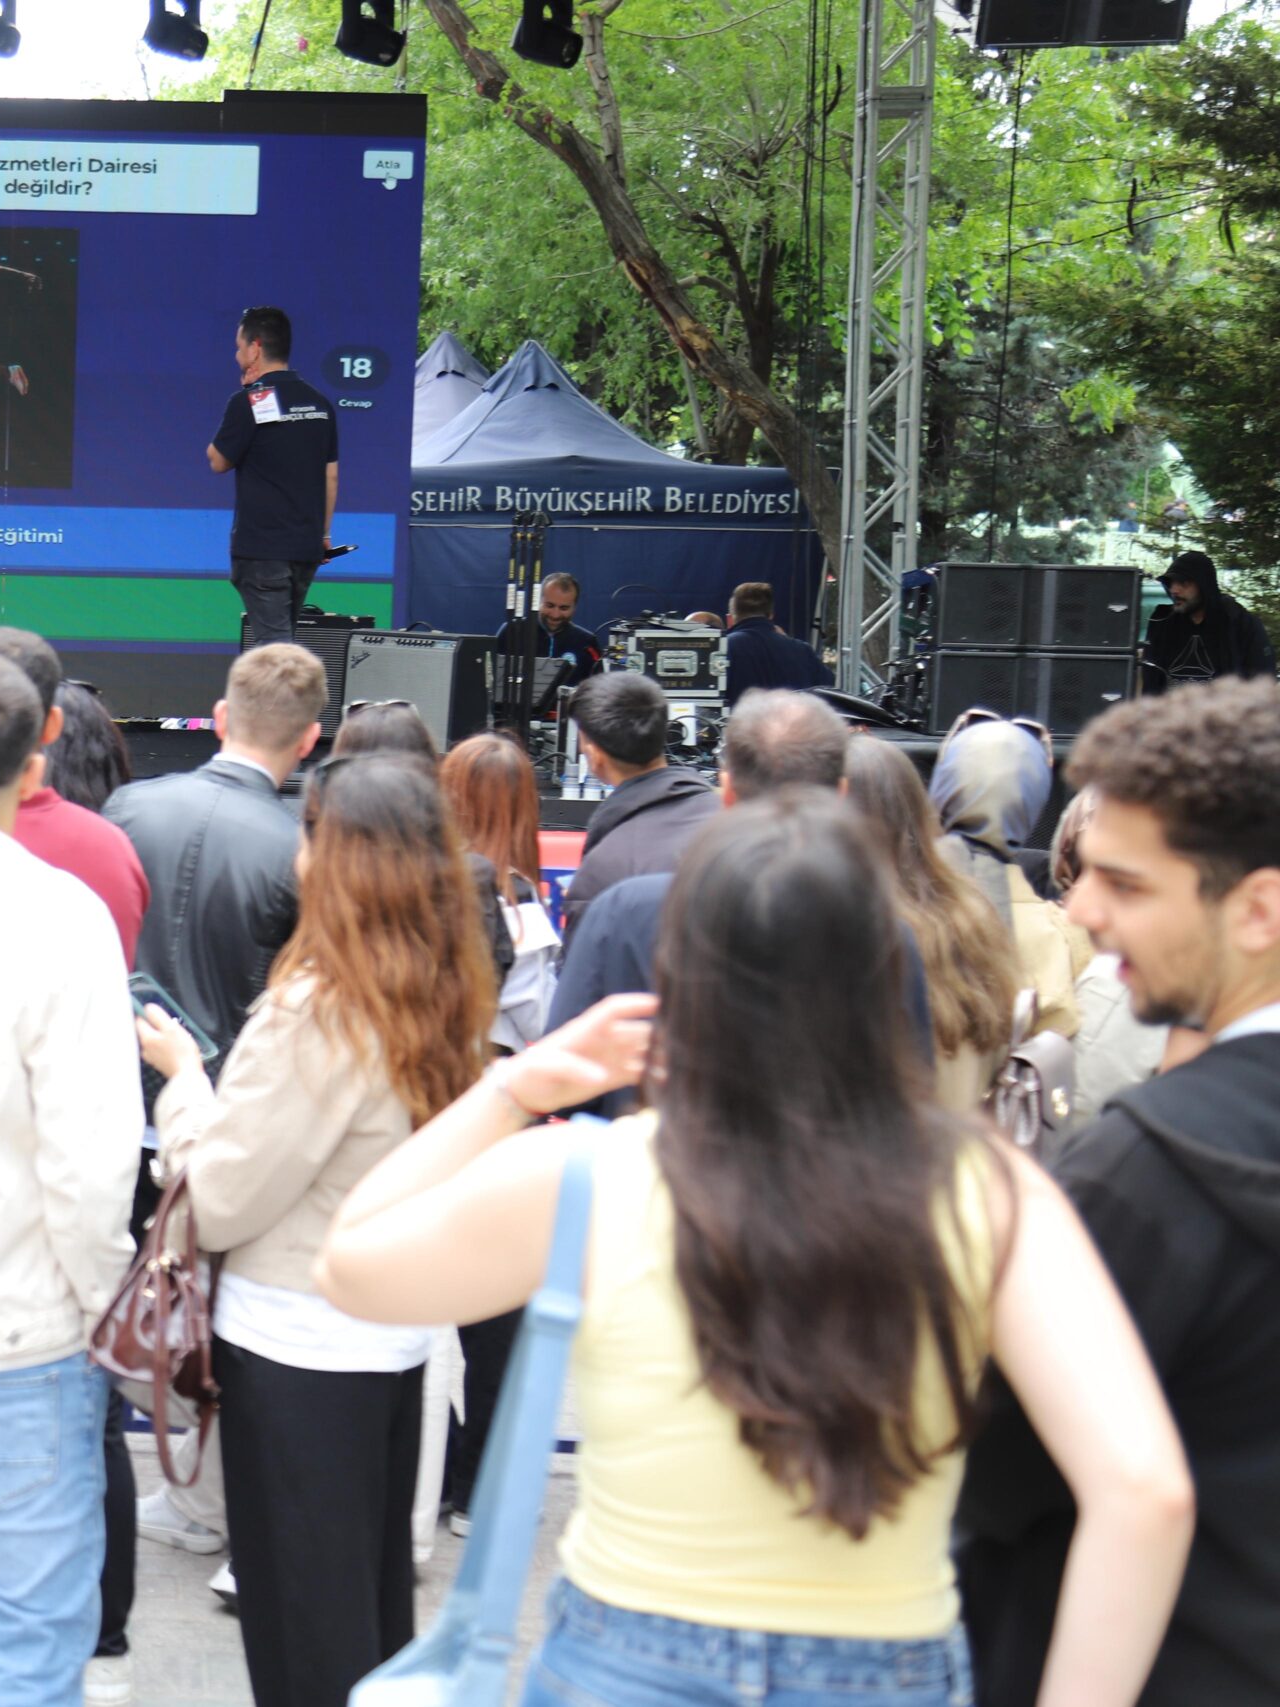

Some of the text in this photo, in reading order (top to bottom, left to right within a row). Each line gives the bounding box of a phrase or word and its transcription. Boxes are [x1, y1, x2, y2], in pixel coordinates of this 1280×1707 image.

[88, 158, 158, 174] Dairesi
[4, 178, 92, 197] değildir?
[339, 357, 373, 379] 18
[338, 398, 373, 409] Cevap
[495, 485, 652, 517] BÜYÜKŞEHİR
